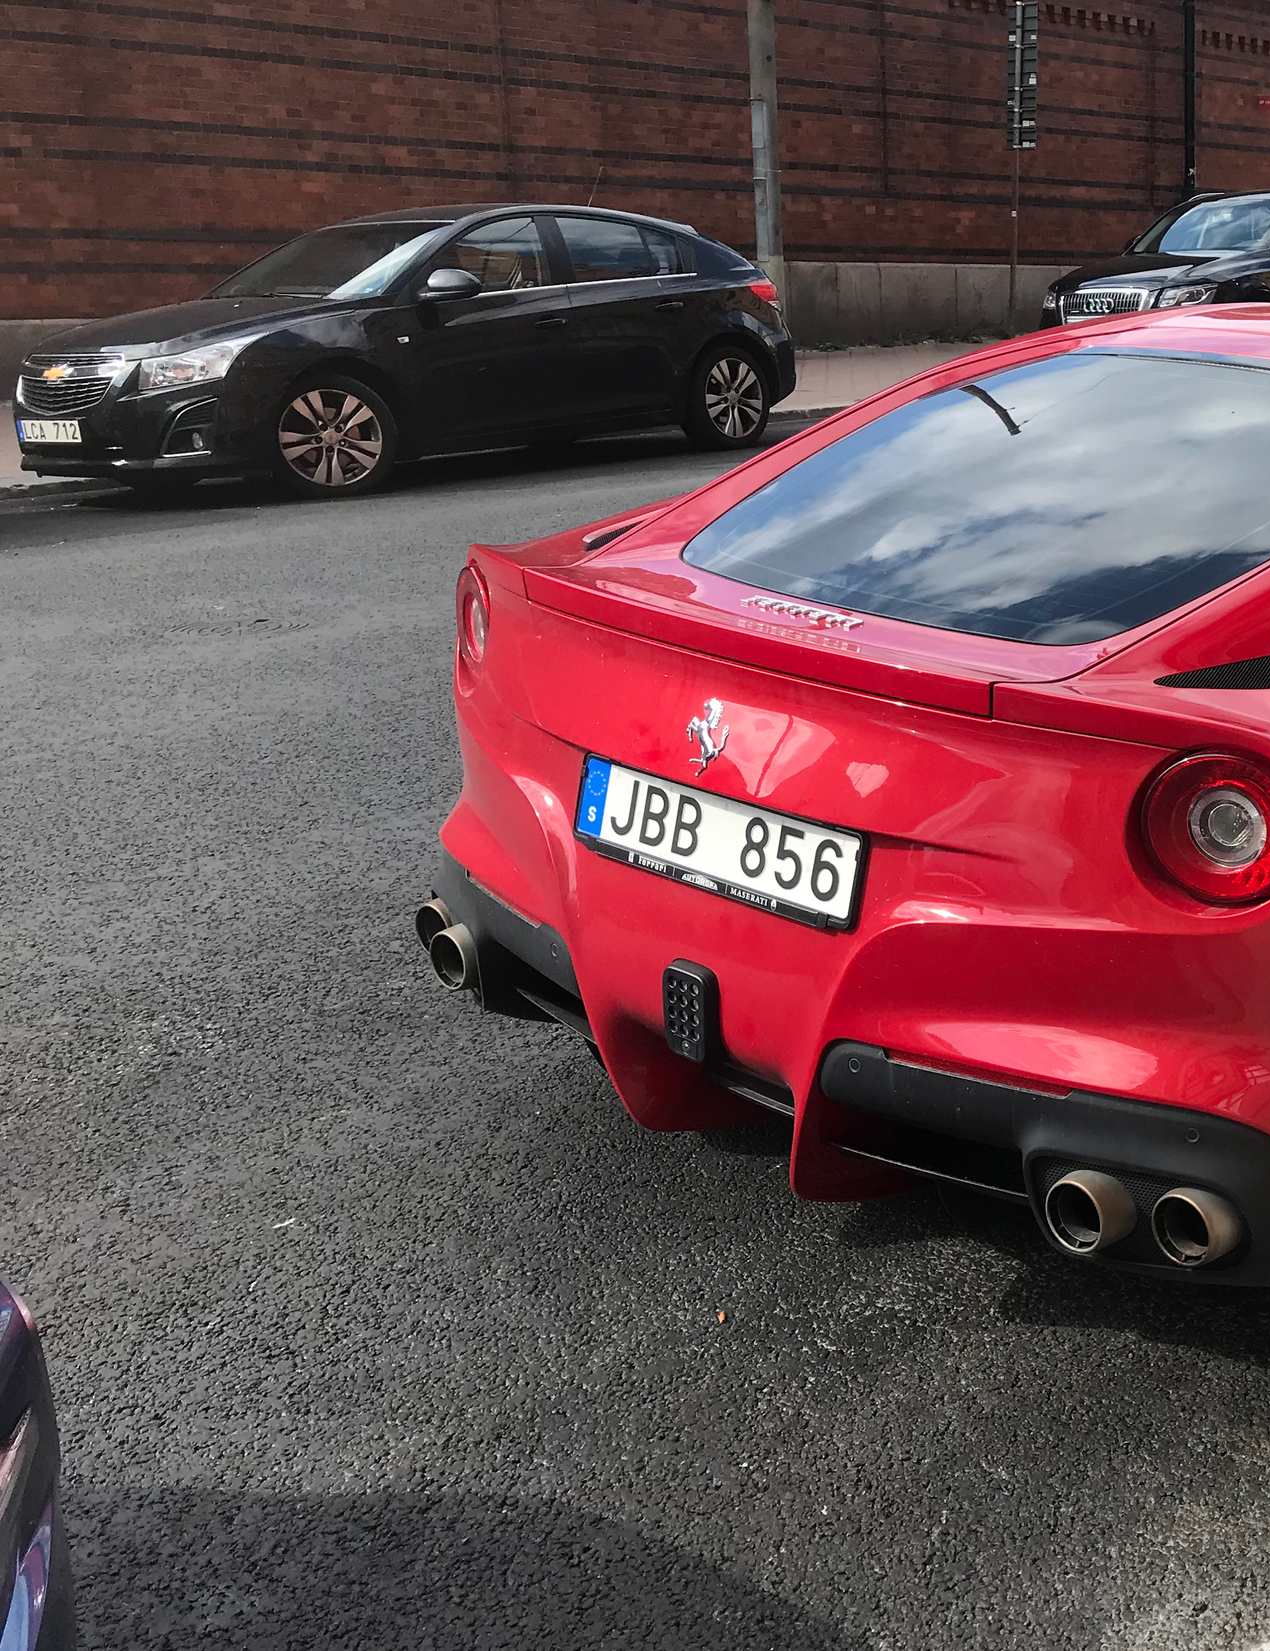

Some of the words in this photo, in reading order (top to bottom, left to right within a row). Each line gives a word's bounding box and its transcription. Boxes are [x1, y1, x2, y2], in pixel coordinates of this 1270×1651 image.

[23, 422, 46, 440] LCA
[52, 422, 78, 440] 712
[587, 806, 597, 822] S
[610, 780, 701, 857] JBB
[740, 817, 843, 902] 856
[638, 852, 667, 873] Ferrari
[730, 886, 768, 907] MASERATI
